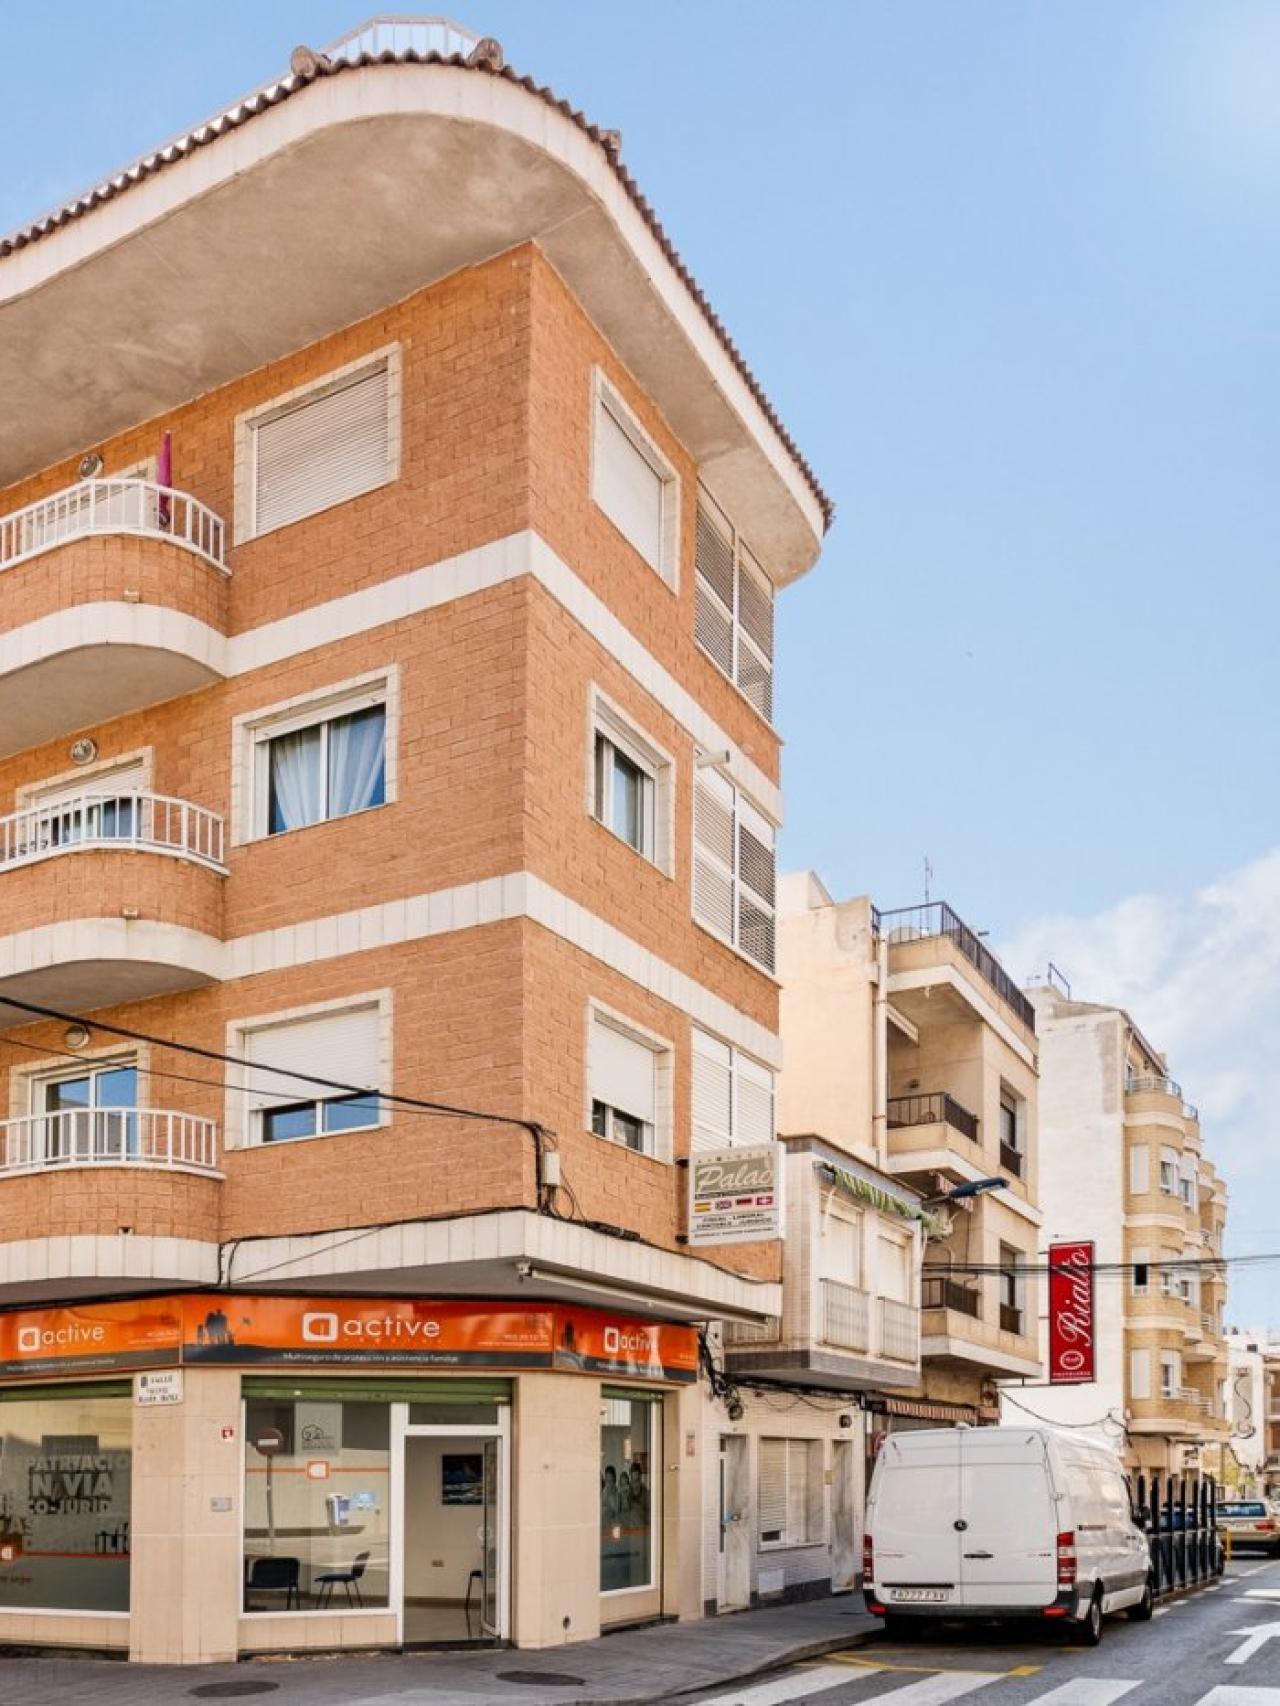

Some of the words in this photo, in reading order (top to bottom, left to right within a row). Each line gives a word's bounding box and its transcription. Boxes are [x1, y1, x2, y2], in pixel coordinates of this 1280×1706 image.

[1053, 1249, 1090, 1347] Rialto
[42, 1322, 105, 1345] active
[343, 1313, 440, 1338] active
